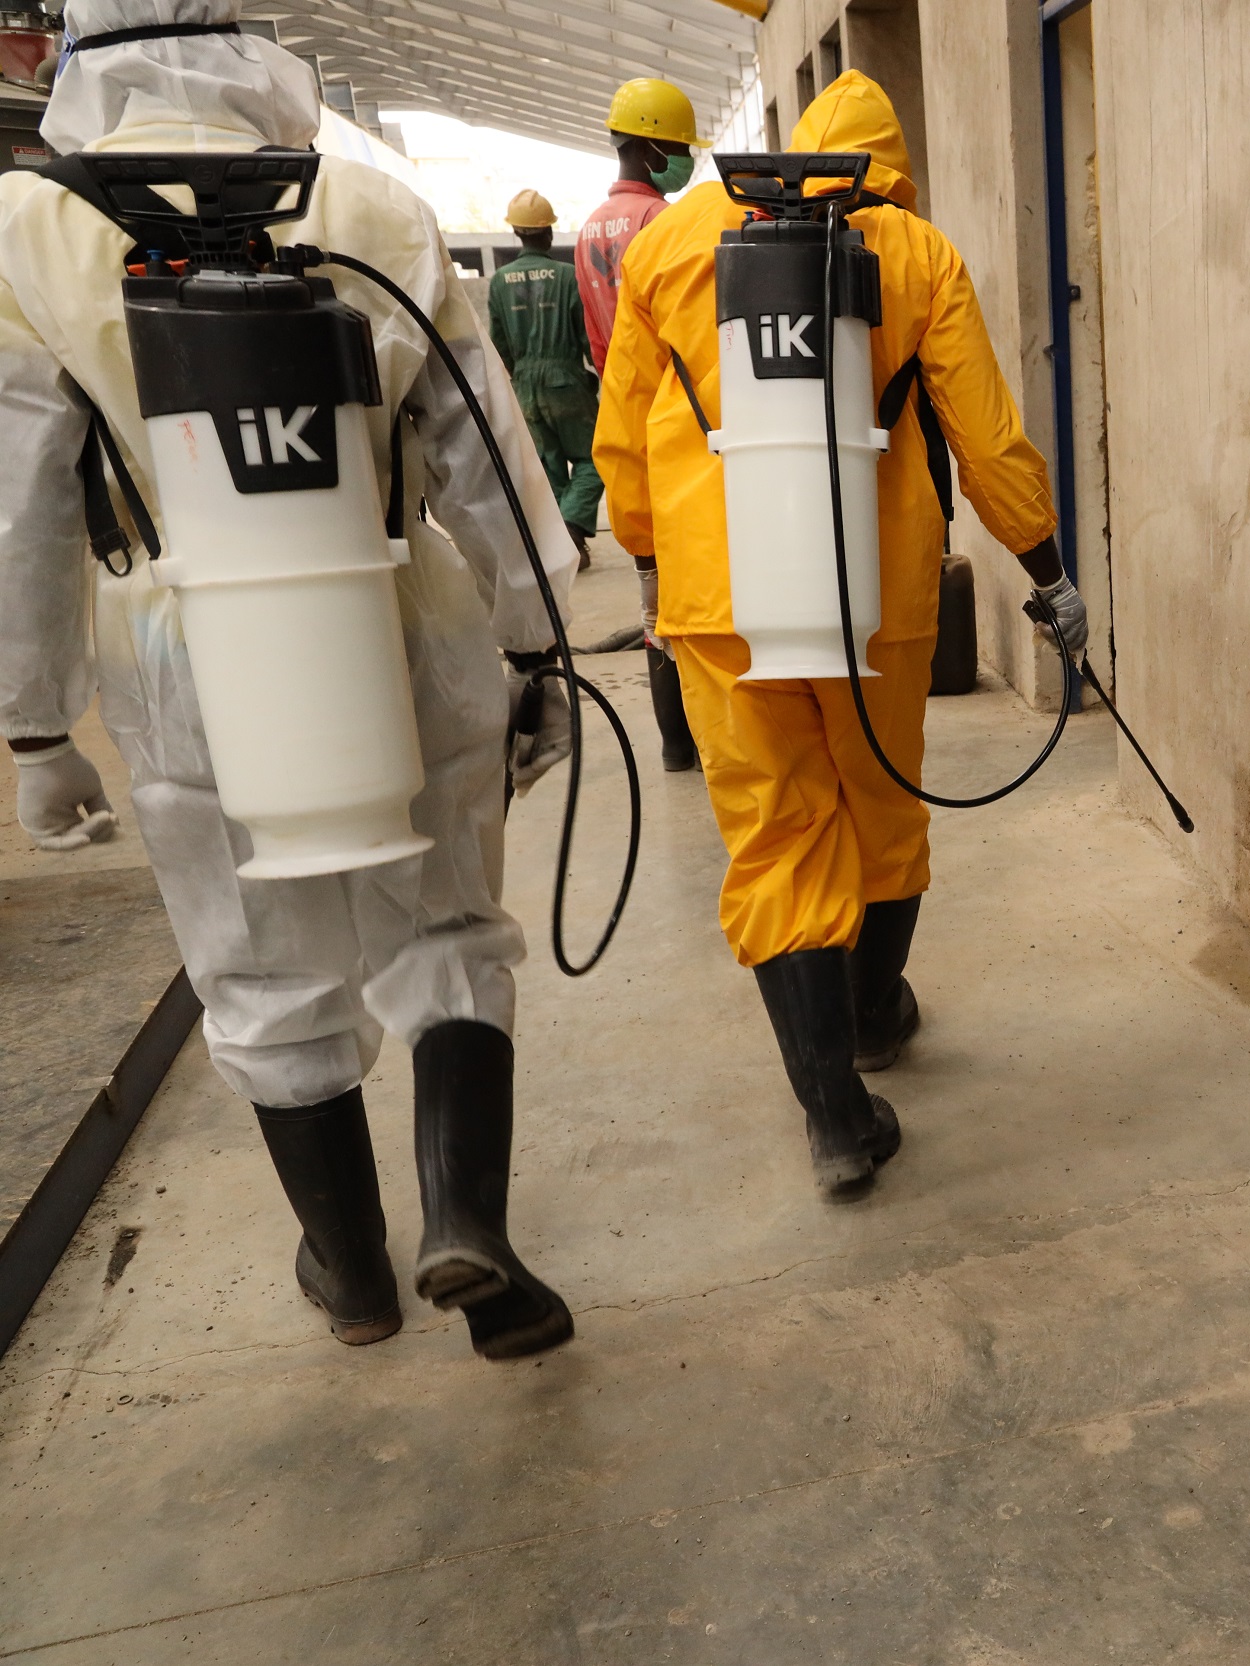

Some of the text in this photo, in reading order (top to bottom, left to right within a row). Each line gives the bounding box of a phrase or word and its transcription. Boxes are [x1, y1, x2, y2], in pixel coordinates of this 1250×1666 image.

[605, 217, 630, 238] BLOC
[504, 269, 555, 283] KEN BLOC
